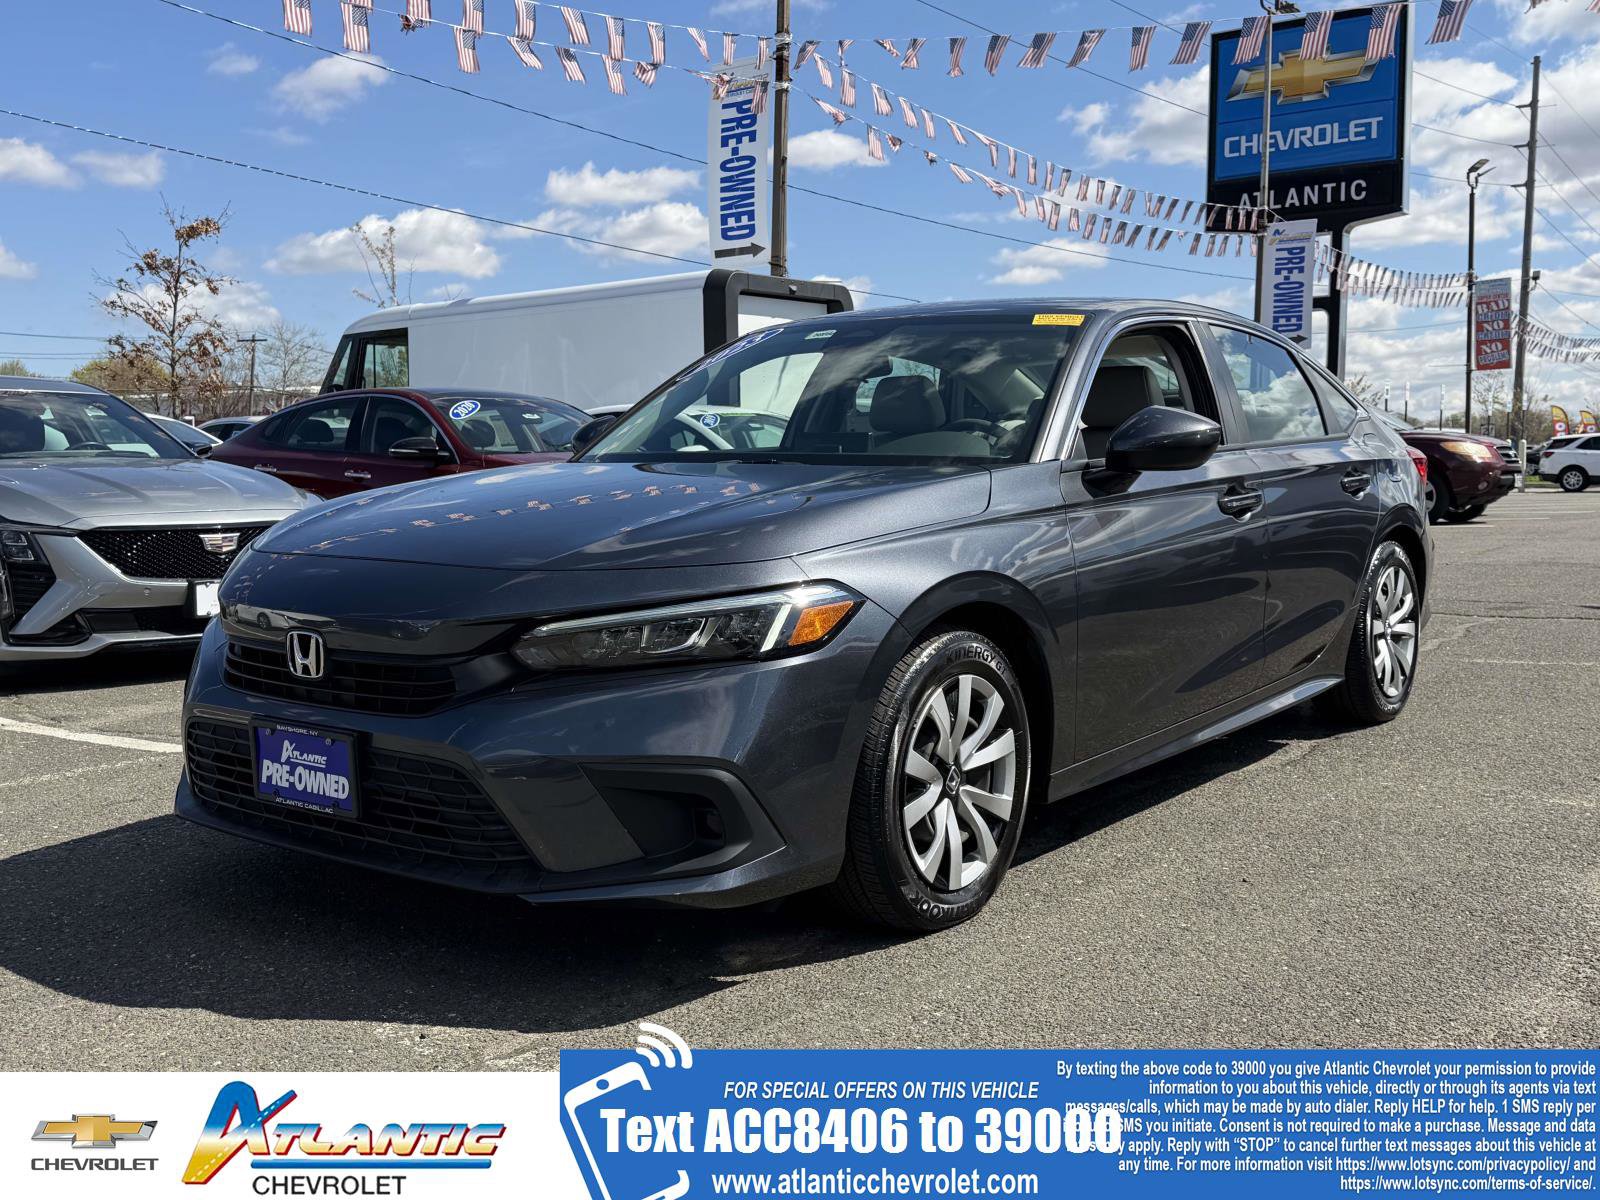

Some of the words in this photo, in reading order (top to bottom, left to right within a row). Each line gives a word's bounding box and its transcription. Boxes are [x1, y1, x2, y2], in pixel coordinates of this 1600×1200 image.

[1224, 116, 1383, 158] CHEVROLET
[720, 99, 758, 241] PRE-OWNED
[1238, 179, 1367, 213] ATLANTIC
[1273, 246, 1306, 333] PRE-OWNED
[1482, 320, 1504, 332] NO
[1481, 341, 1503, 354] NO
[281, 740, 327, 765] ATLANTIC
[261, 759, 350, 800] PRE-OWNED
[304, 803, 334, 814] CADILLAC
